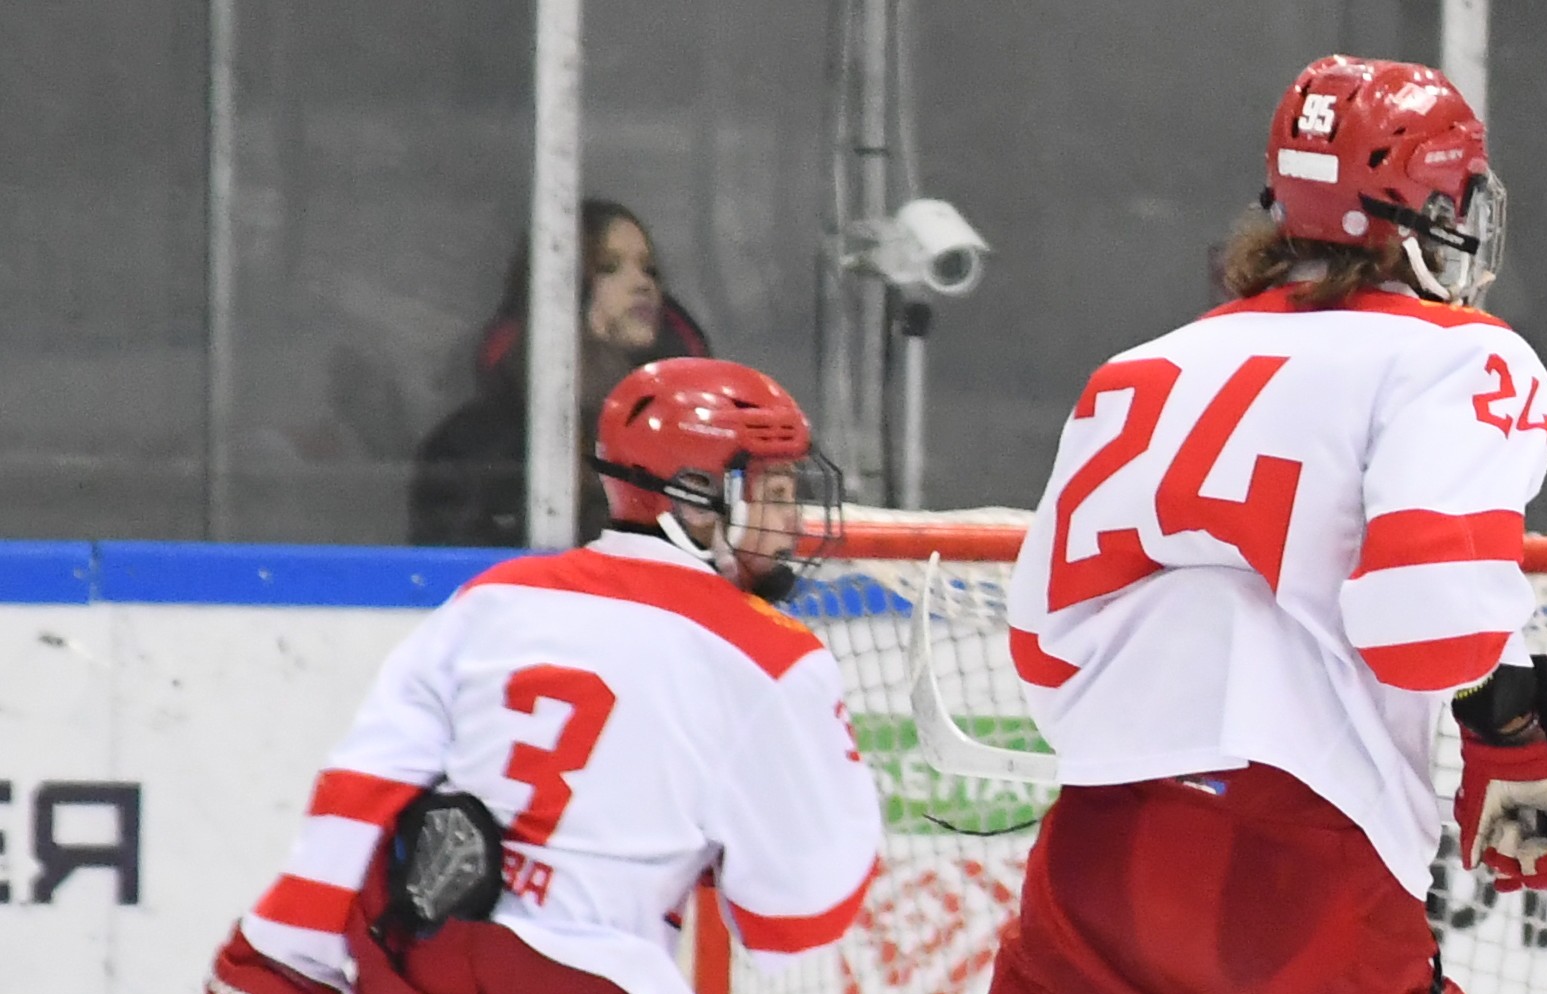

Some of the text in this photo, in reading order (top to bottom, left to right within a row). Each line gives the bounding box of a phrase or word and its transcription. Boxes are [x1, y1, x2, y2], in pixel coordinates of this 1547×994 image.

[1298, 93, 1338, 135] 95
[1047, 355, 1304, 613] 24
[502, 662, 618, 847] 3
